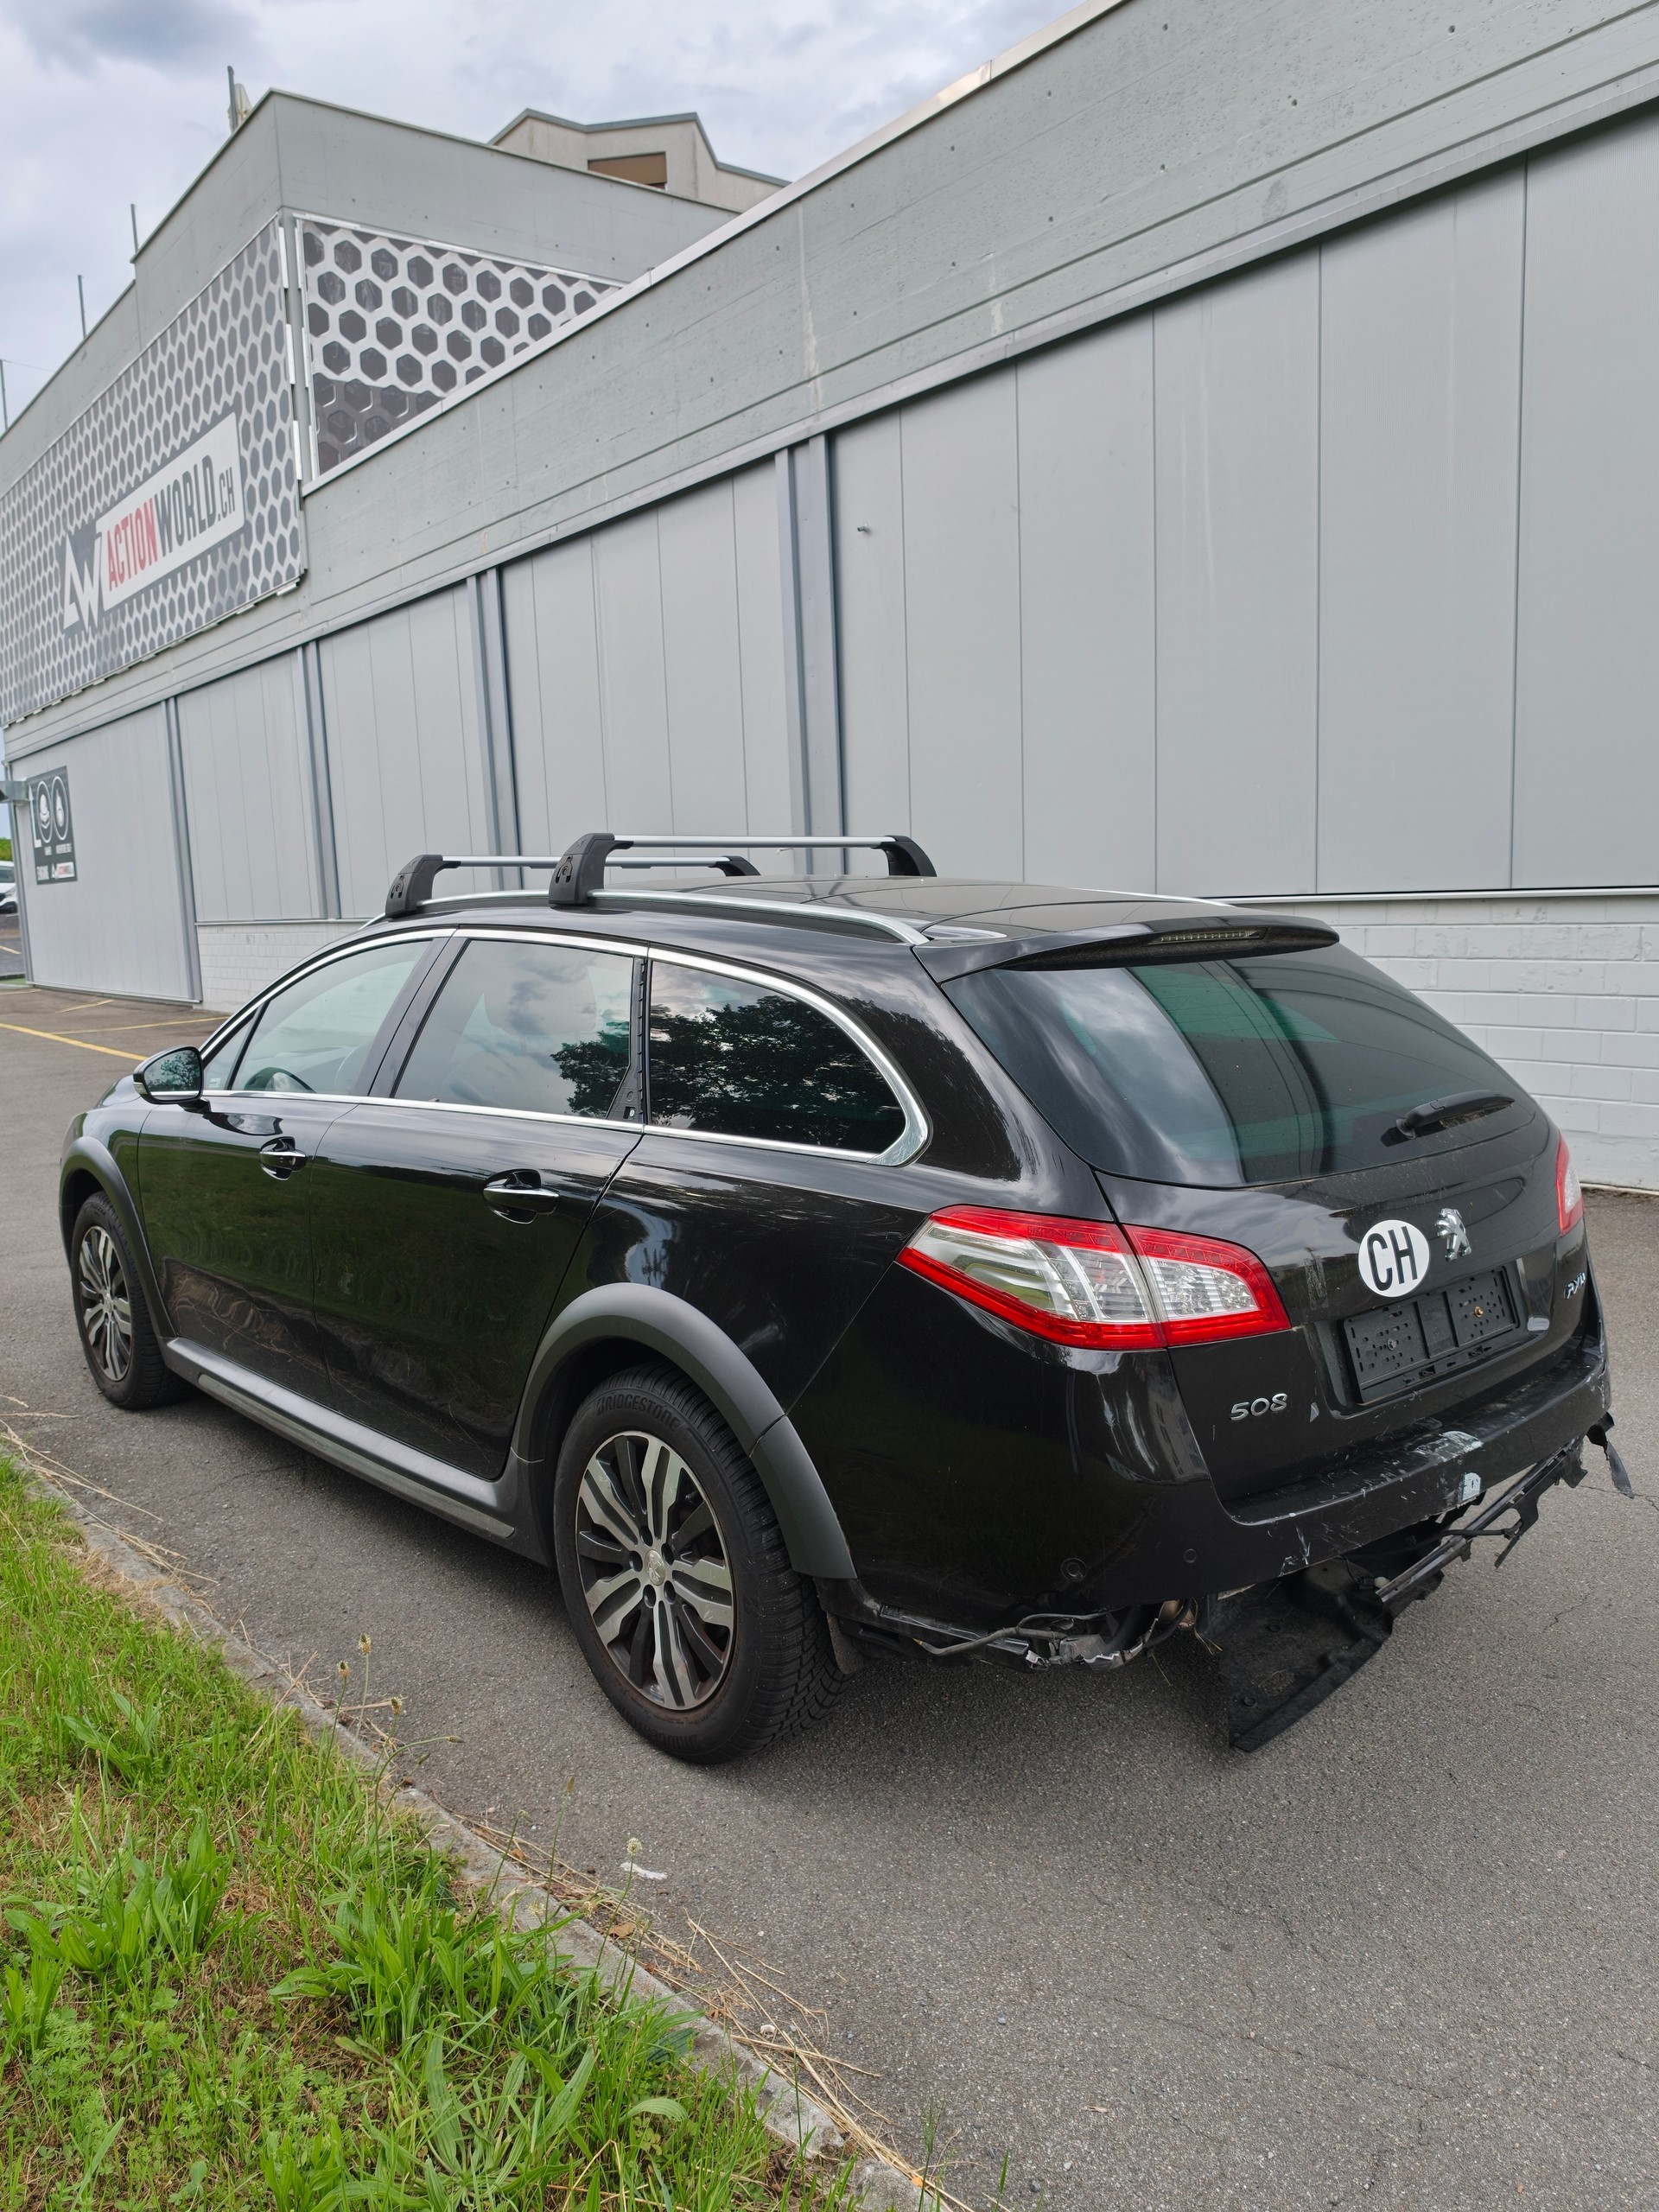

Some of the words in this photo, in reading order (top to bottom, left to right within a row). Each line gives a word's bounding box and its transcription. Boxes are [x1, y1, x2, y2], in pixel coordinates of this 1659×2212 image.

[106, 454, 236, 592] ACTIONWORLD.CH
[1366, 1225, 1419, 1293] CH
[596, 1392, 681, 1433] BRIDGESTONE
[1229, 1392, 1289, 1421] 508
